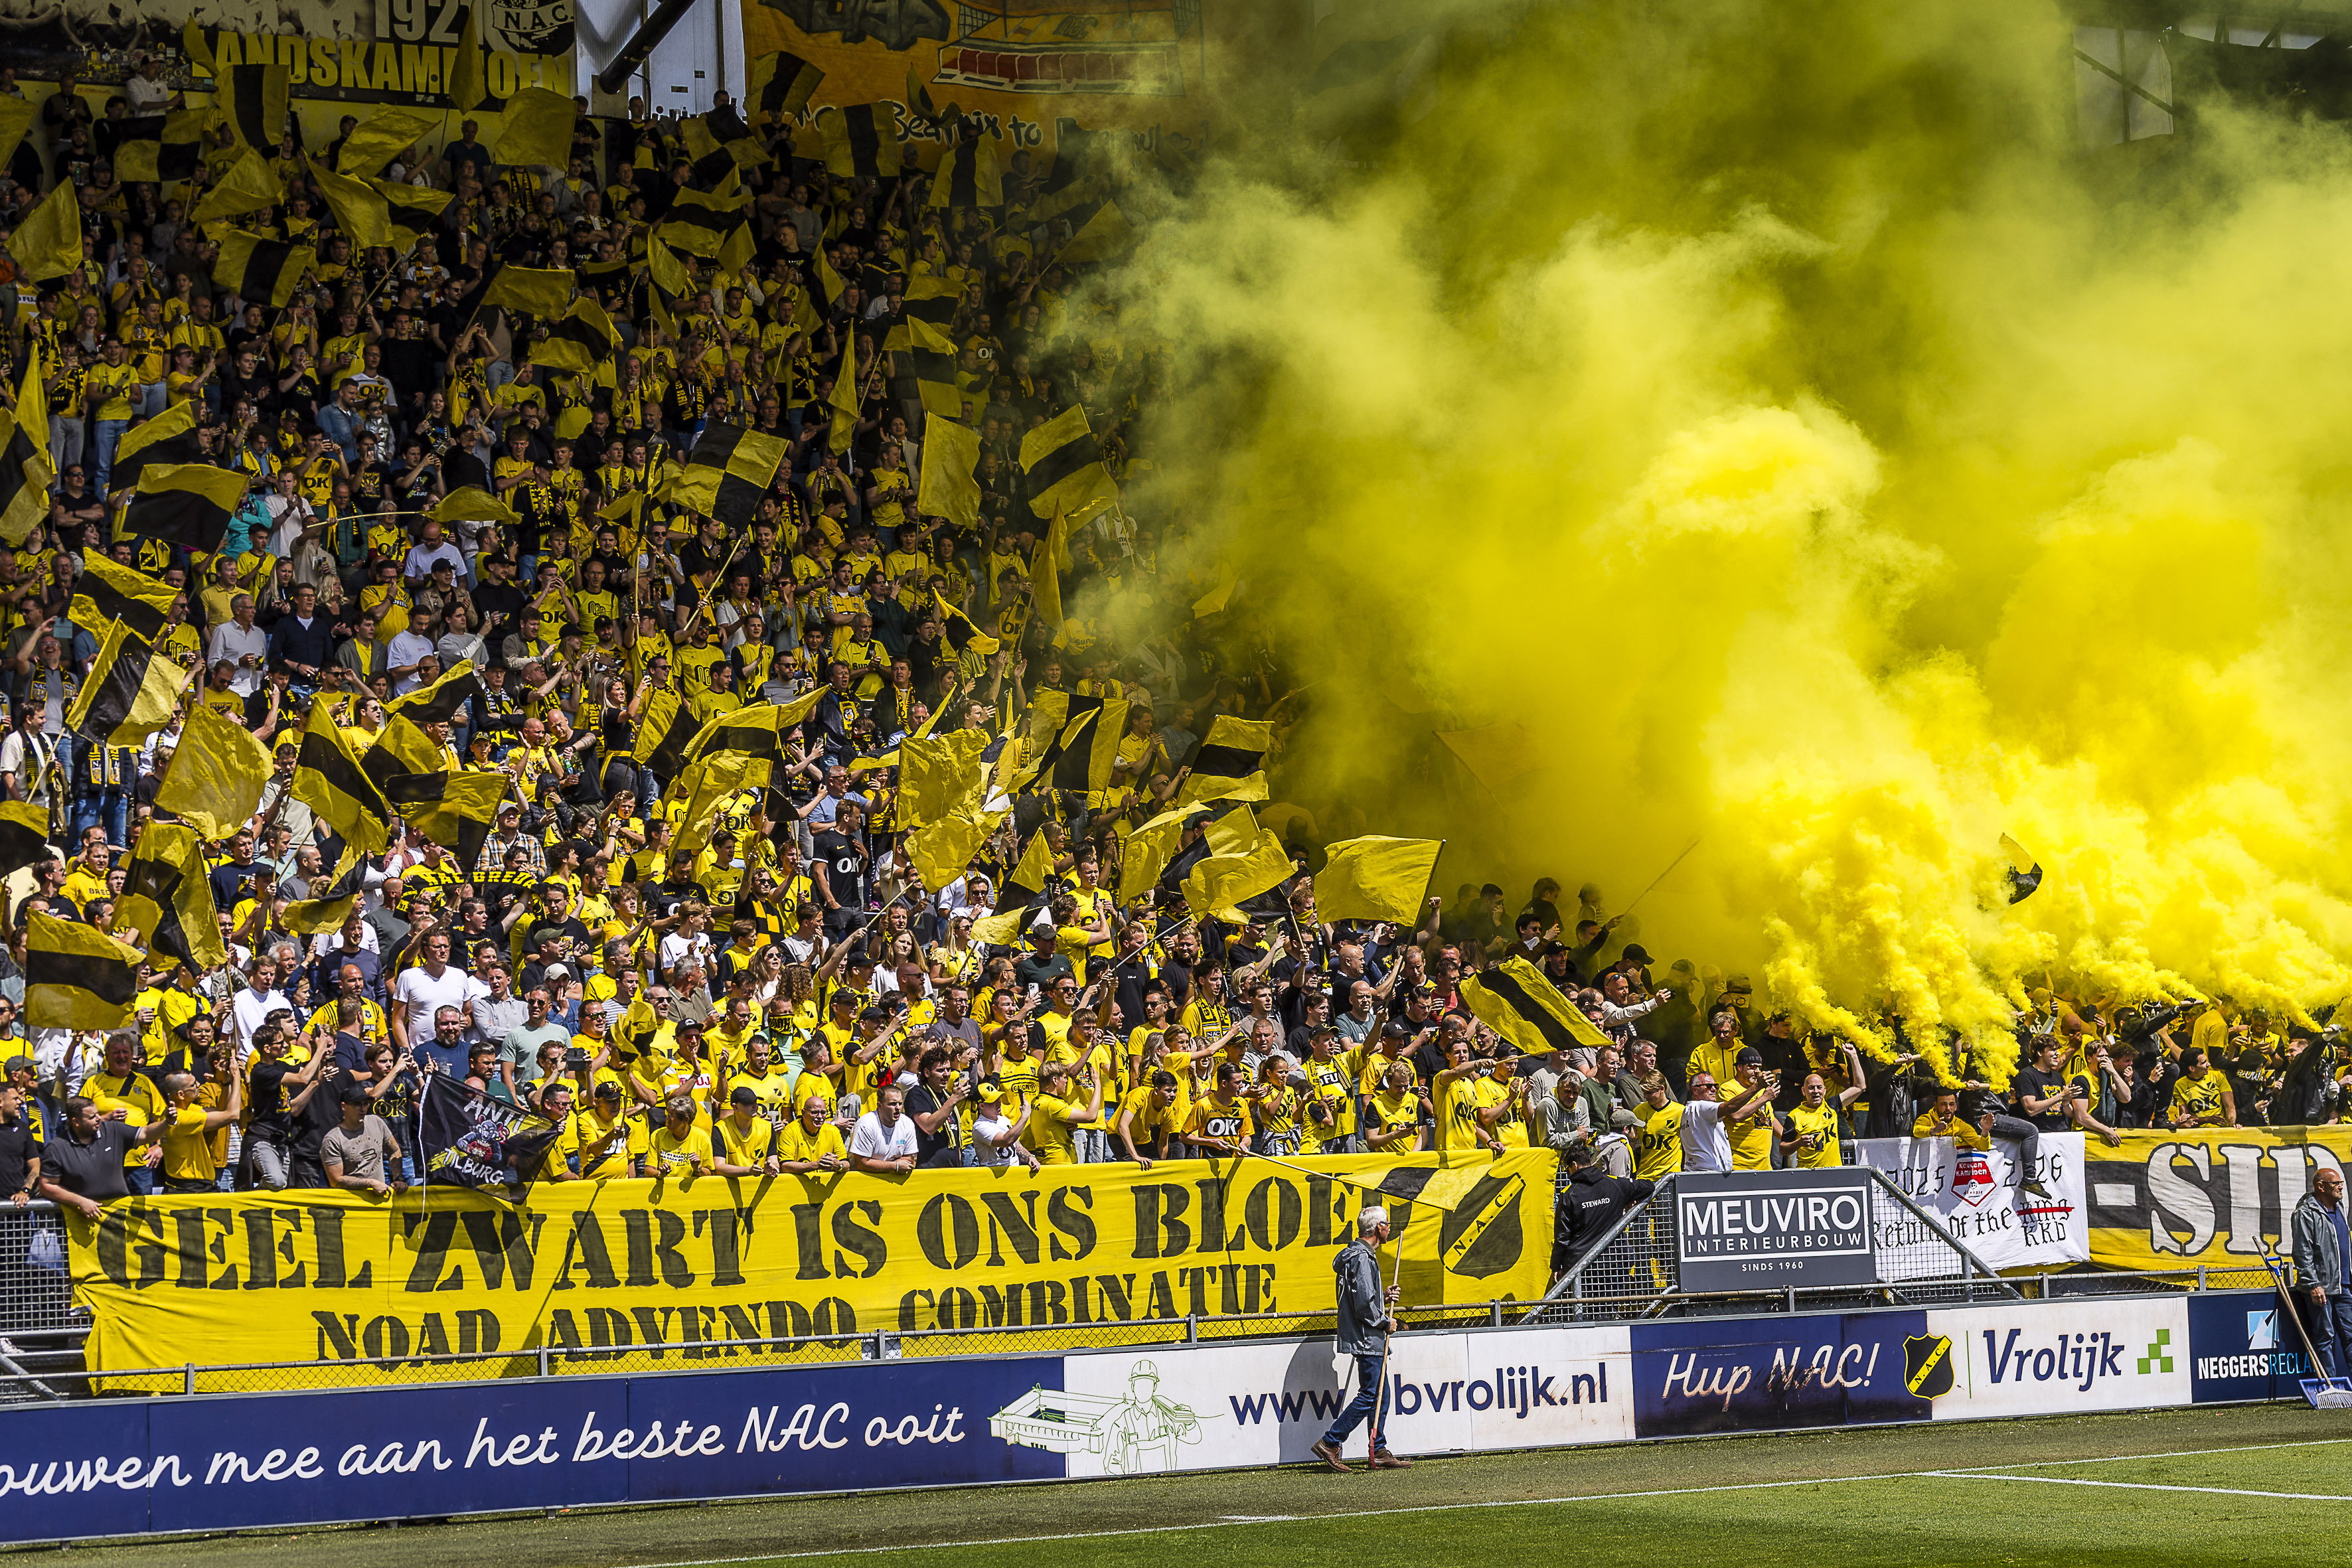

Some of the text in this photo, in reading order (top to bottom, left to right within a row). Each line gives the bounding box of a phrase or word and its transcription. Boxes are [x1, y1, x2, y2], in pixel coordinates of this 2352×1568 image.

[375, 0, 484, 44] 192
[193, 30, 570, 98] ANDSKAMOEN
[1007, 114, 1042, 149] to
[360, 384, 386, 397] OK
[563, 397, 588, 409] OK
[305, 477, 329, 490] OK
[542, 611, 568, 623] OK
[473, 870, 536, 889] BREDA
[374, 1099, 408, 1119] OK
[464, 1095, 524, 1133] ANTI
[1456, 1102, 1478, 1123] OK
[2189, 1095, 2221, 1111] OK
[1208, 1119, 1241, 1136] OK
[1644, 1134, 1674, 1151] OK
[443, 1147, 504, 1185] TILBURG
[1885, 1153, 2062, 1199] 2025 226
[1581, 1198, 1610, 1209] STEWARD
[1686, 1195, 1861, 1236] MEUVIRO
[1975, 1206, 2012, 1236] the
[96, 1207, 372, 1291] GEEL
[402, 1208, 754, 1292] ZWART
[790, 1200, 888, 1280] IS
[917, 1185, 1097, 1270] ONS
[1687, 1232, 1862, 1253] INTERIEURBOUW
[1742, 1261, 1803, 1272] SINDS 1960
[311, 1263, 1277, 1372] NOAD ADVENDO COMBINATIE
[1983, 1328, 2125, 1392] Vrolijk
[1662, 1343, 1880, 1413] Hup NAC!
[204, 1447, 324, 1484] mee
[338, 1439, 452, 1476] aan
[465, 1417, 560, 1468] het
[572, 1412, 726, 1461] beste
[736, 1402, 850, 1453] NAC
[865, 1404, 965, 1446] ooit
